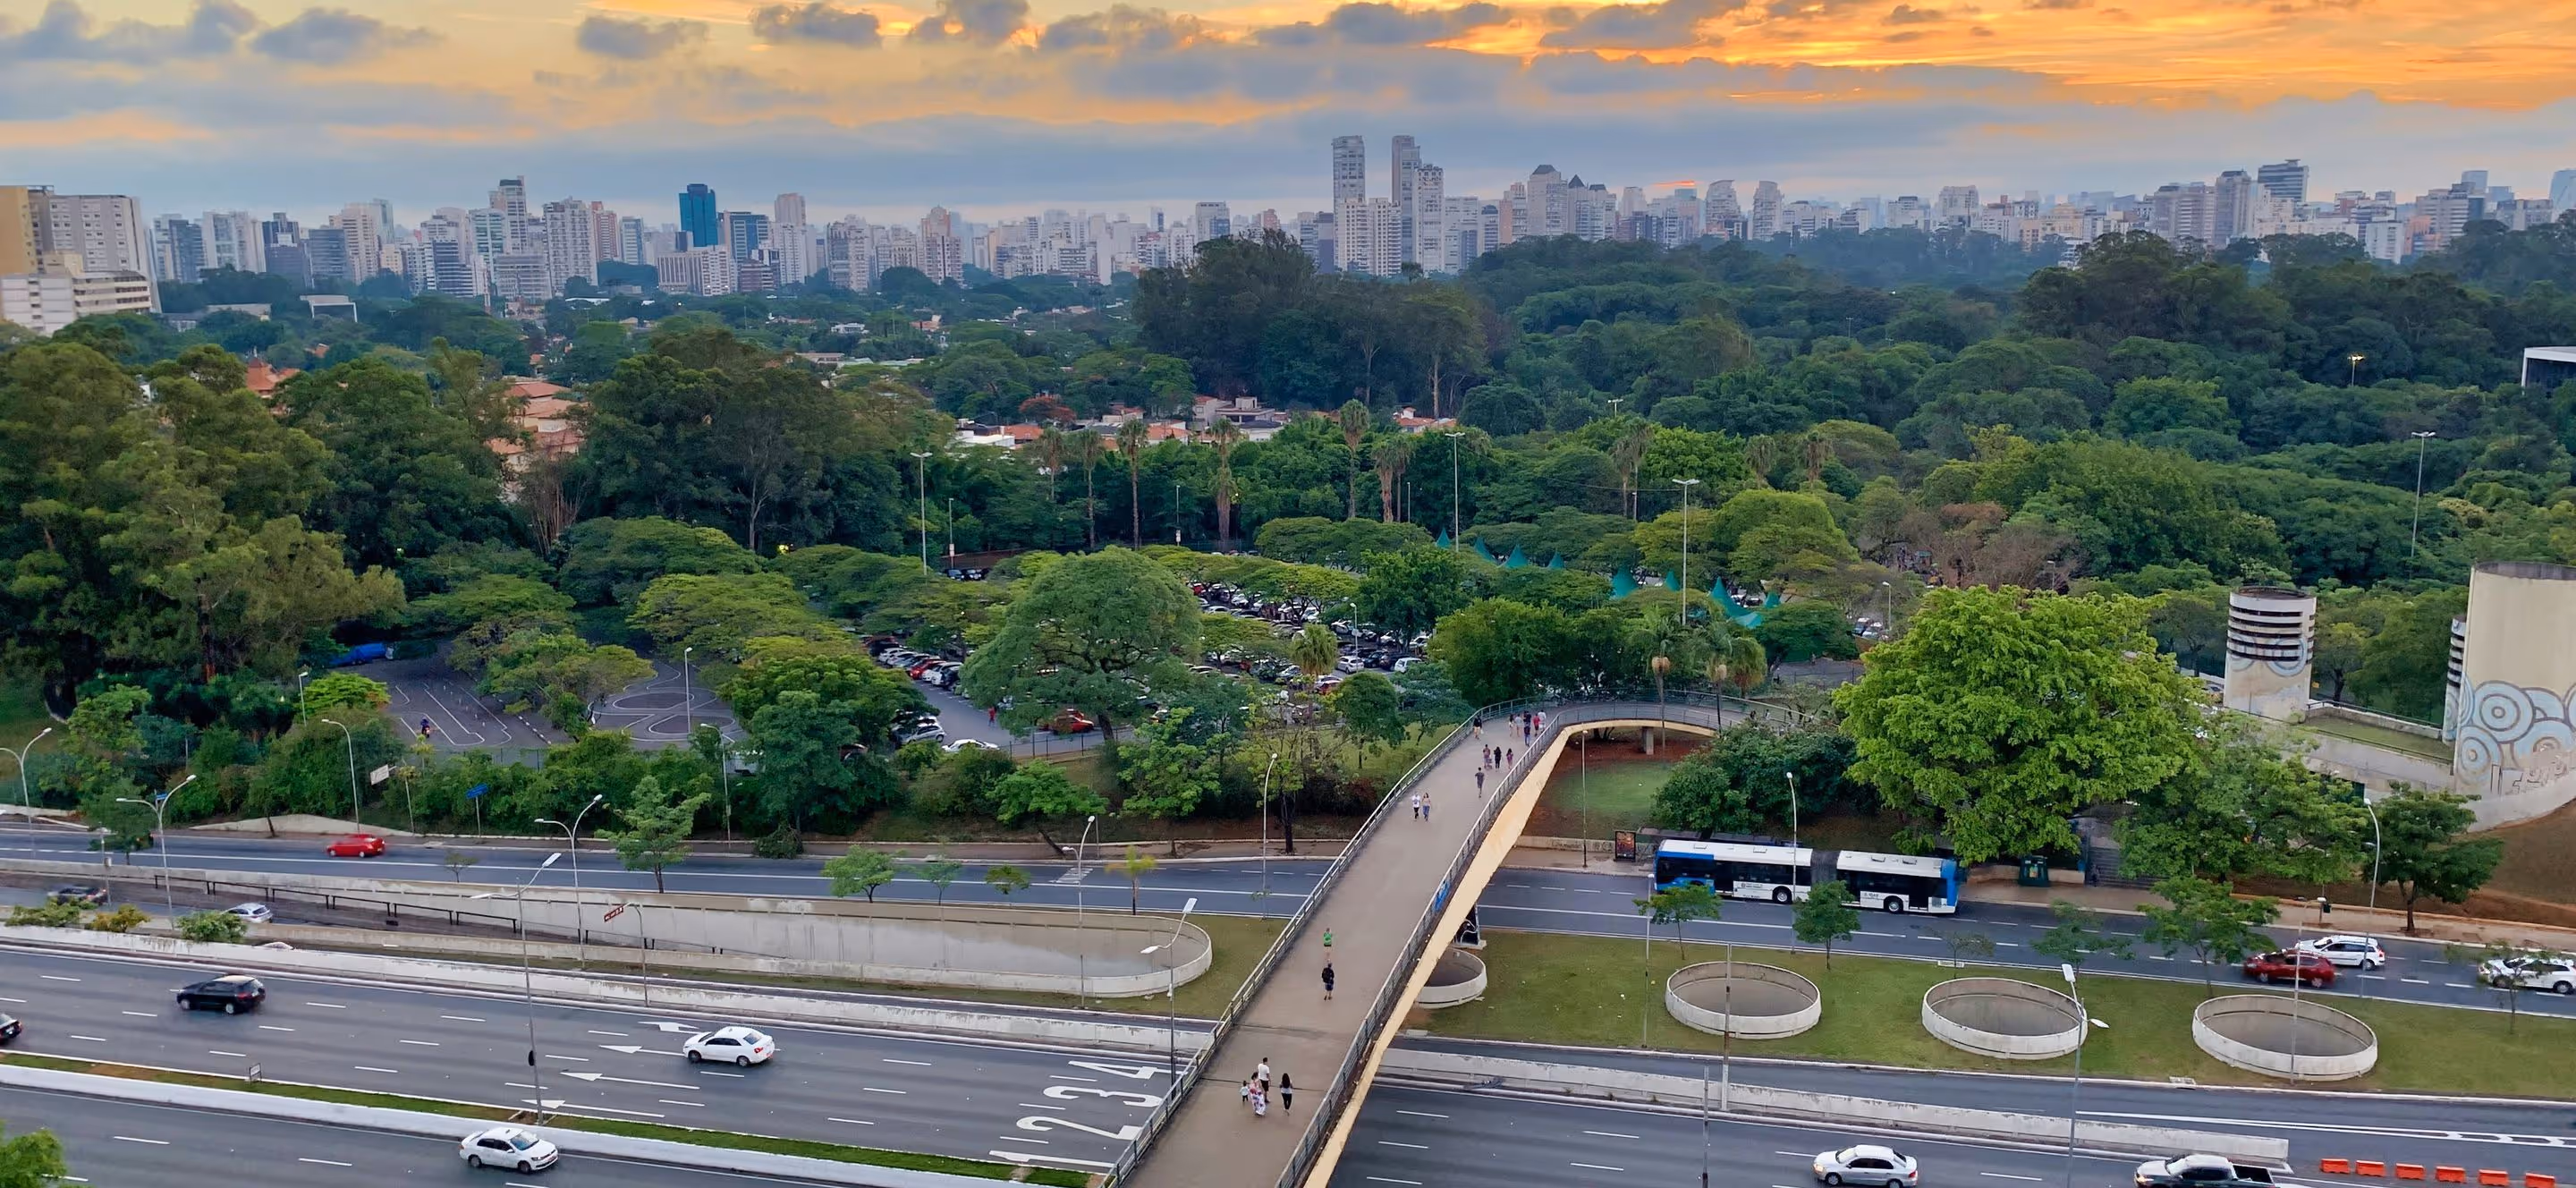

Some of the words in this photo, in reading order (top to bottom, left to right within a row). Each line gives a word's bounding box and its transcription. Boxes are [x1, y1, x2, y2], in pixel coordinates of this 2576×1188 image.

[1068, 1060, 1189, 1080] 4
[1043, 1085, 1163, 1107] 3
[1016, 1116, 1144, 1141] 2
[988, 1150, 1118, 1168] 1
